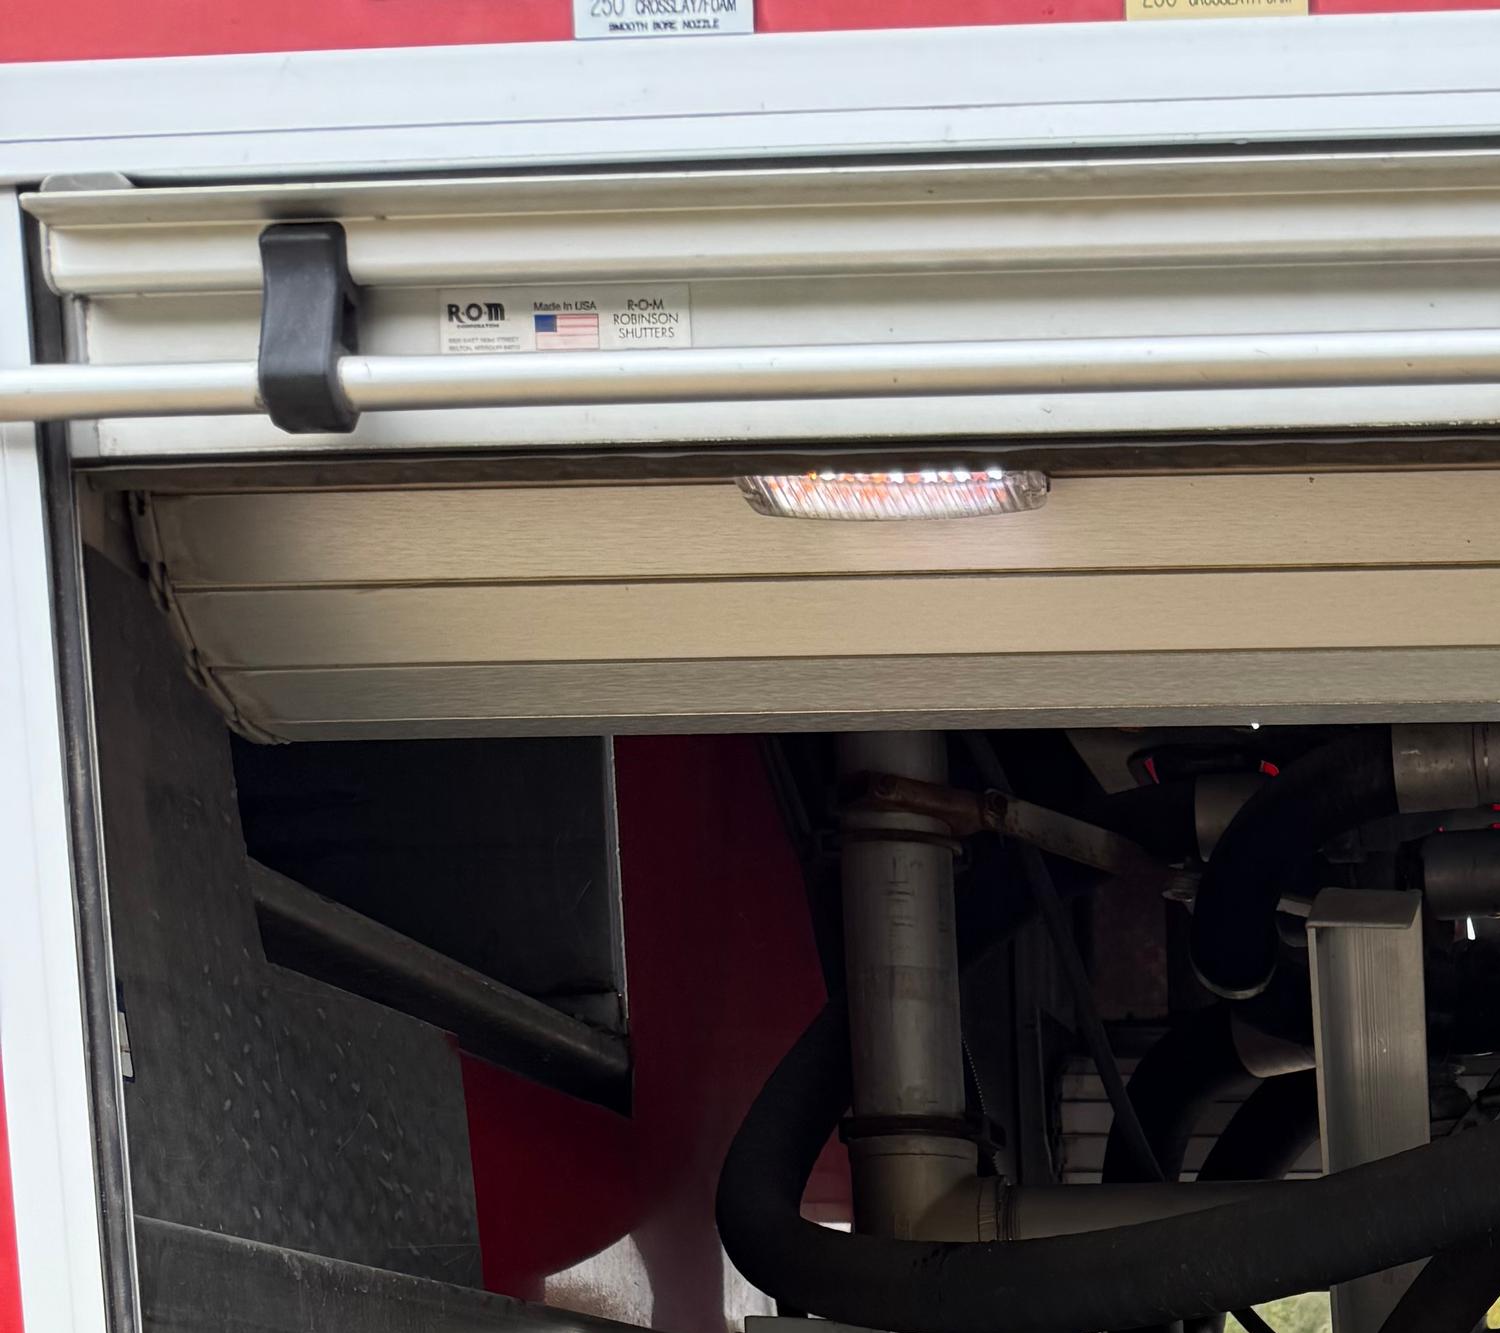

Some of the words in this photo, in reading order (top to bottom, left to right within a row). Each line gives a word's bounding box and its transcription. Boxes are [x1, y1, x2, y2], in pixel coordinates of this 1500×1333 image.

[533, 302, 560, 311] Made
[575, 301, 597, 310] USA
[613, 313, 679, 325] ROBINSON
[618, 327, 675, 340] SHUTTERS
